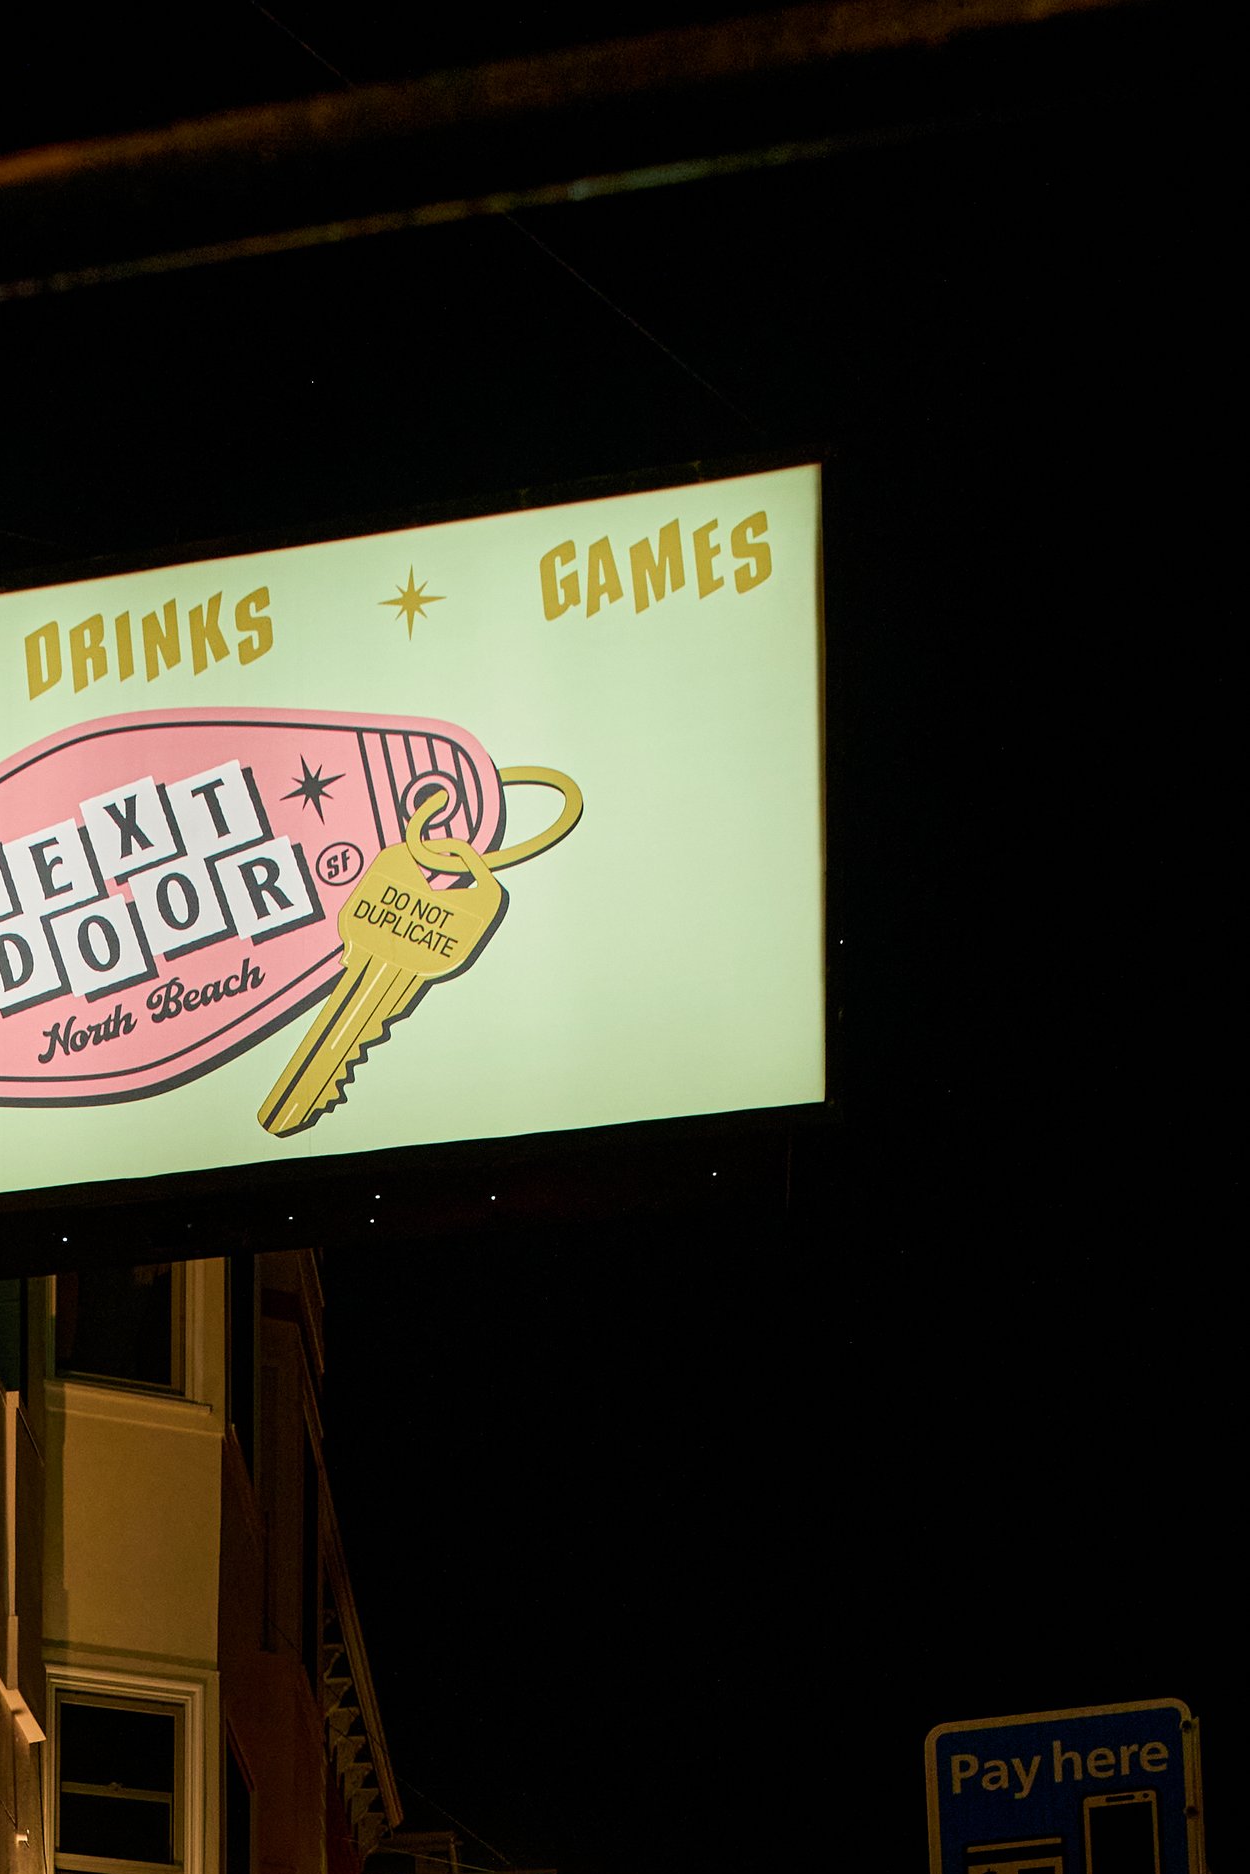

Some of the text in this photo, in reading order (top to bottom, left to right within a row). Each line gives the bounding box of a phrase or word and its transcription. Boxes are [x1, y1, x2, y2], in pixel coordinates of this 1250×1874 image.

[23, 585, 274, 701] DRINKS
[539, 509, 773, 622] GAMES
[326, 848, 351, 880] SF
[353, 899, 459, 958] DUPLICATE
[380, 885, 454, 929] DO NOT
[37, 957, 266, 1065] North Beach
[949, 1738, 1170, 1800] Pay here
